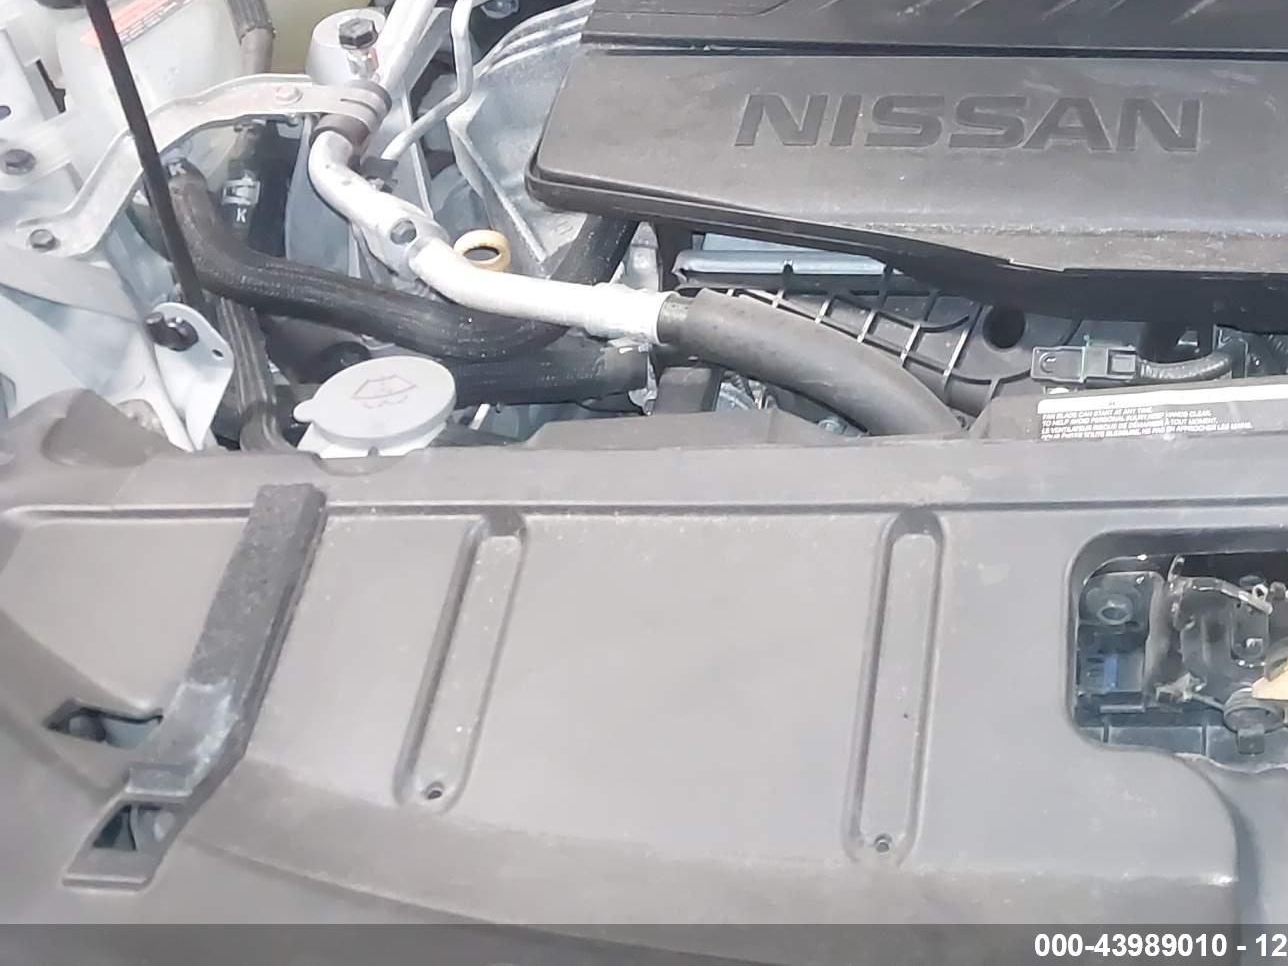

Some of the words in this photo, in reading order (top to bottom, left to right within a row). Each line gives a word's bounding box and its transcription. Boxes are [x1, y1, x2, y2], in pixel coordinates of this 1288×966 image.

[734, 93, 1201, 153] NISSAN
[236, 207, 248, 223] K
[1079, 410, 1092, 418] CAN
[1122, 407, 1137, 416] ANY
[1053, 418, 1070, 426] HELP
[1070, 417, 1090, 425] AVOID
[1171, 417, 1187, 426] TOUT
